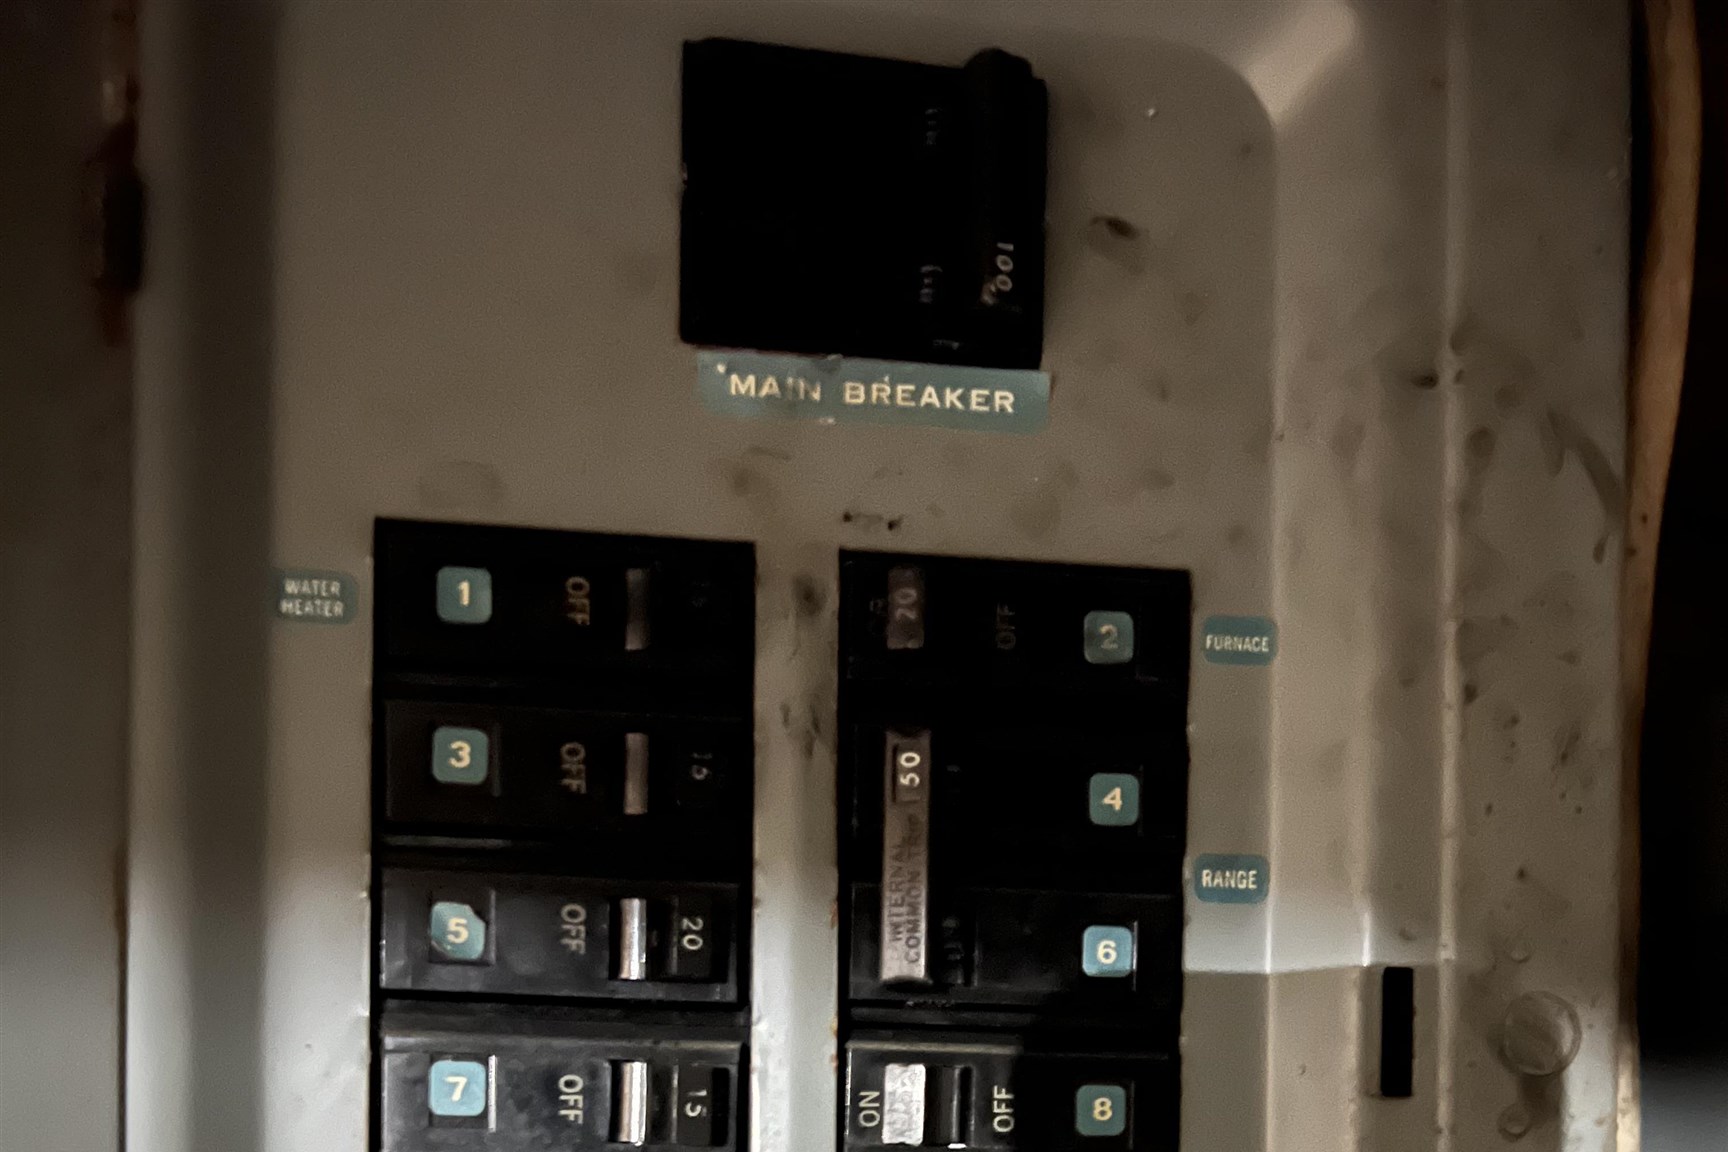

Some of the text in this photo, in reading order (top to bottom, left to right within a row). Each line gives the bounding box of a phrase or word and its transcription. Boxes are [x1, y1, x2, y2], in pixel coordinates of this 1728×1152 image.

[993, 240, 1015, 293] 100
[728, 373, 1016, 414] MAIN BREAKER
[283, 577, 341, 597] WATER
[457, 579, 471, 608] 1
[564, 575, 592, 628] OFF
[279, 598, 345, 619] HEATER
[1099, 624, 1119, 651] 2
[1205, 633, 1270, 653] FURNACE
[449, 740, 471, 769] 3
[560, 741, 588, 795] OFF
[899, 751, 921, 788] 50
[1103, 786, 1123, 811] 4
[1201, 869, 1259, 890] RANGE
[447, 917, 470, 944] 5
[560, 903, 588, 955] OFF
[902, 869, 923, 964] COMMON
[681, 917, 704, 952] 20
[1096, 939, 1118, 964] 6
[444, 1075, 468, 1102] 7
[558, 1073, 584, 1125] OFF
[684, 1088, 708, 1119] 15
[858, 1089, 881, 1129] ON
[992, 1085, 1016, 1134] OFF
[1092, 1097, 1114, 1122] 8
